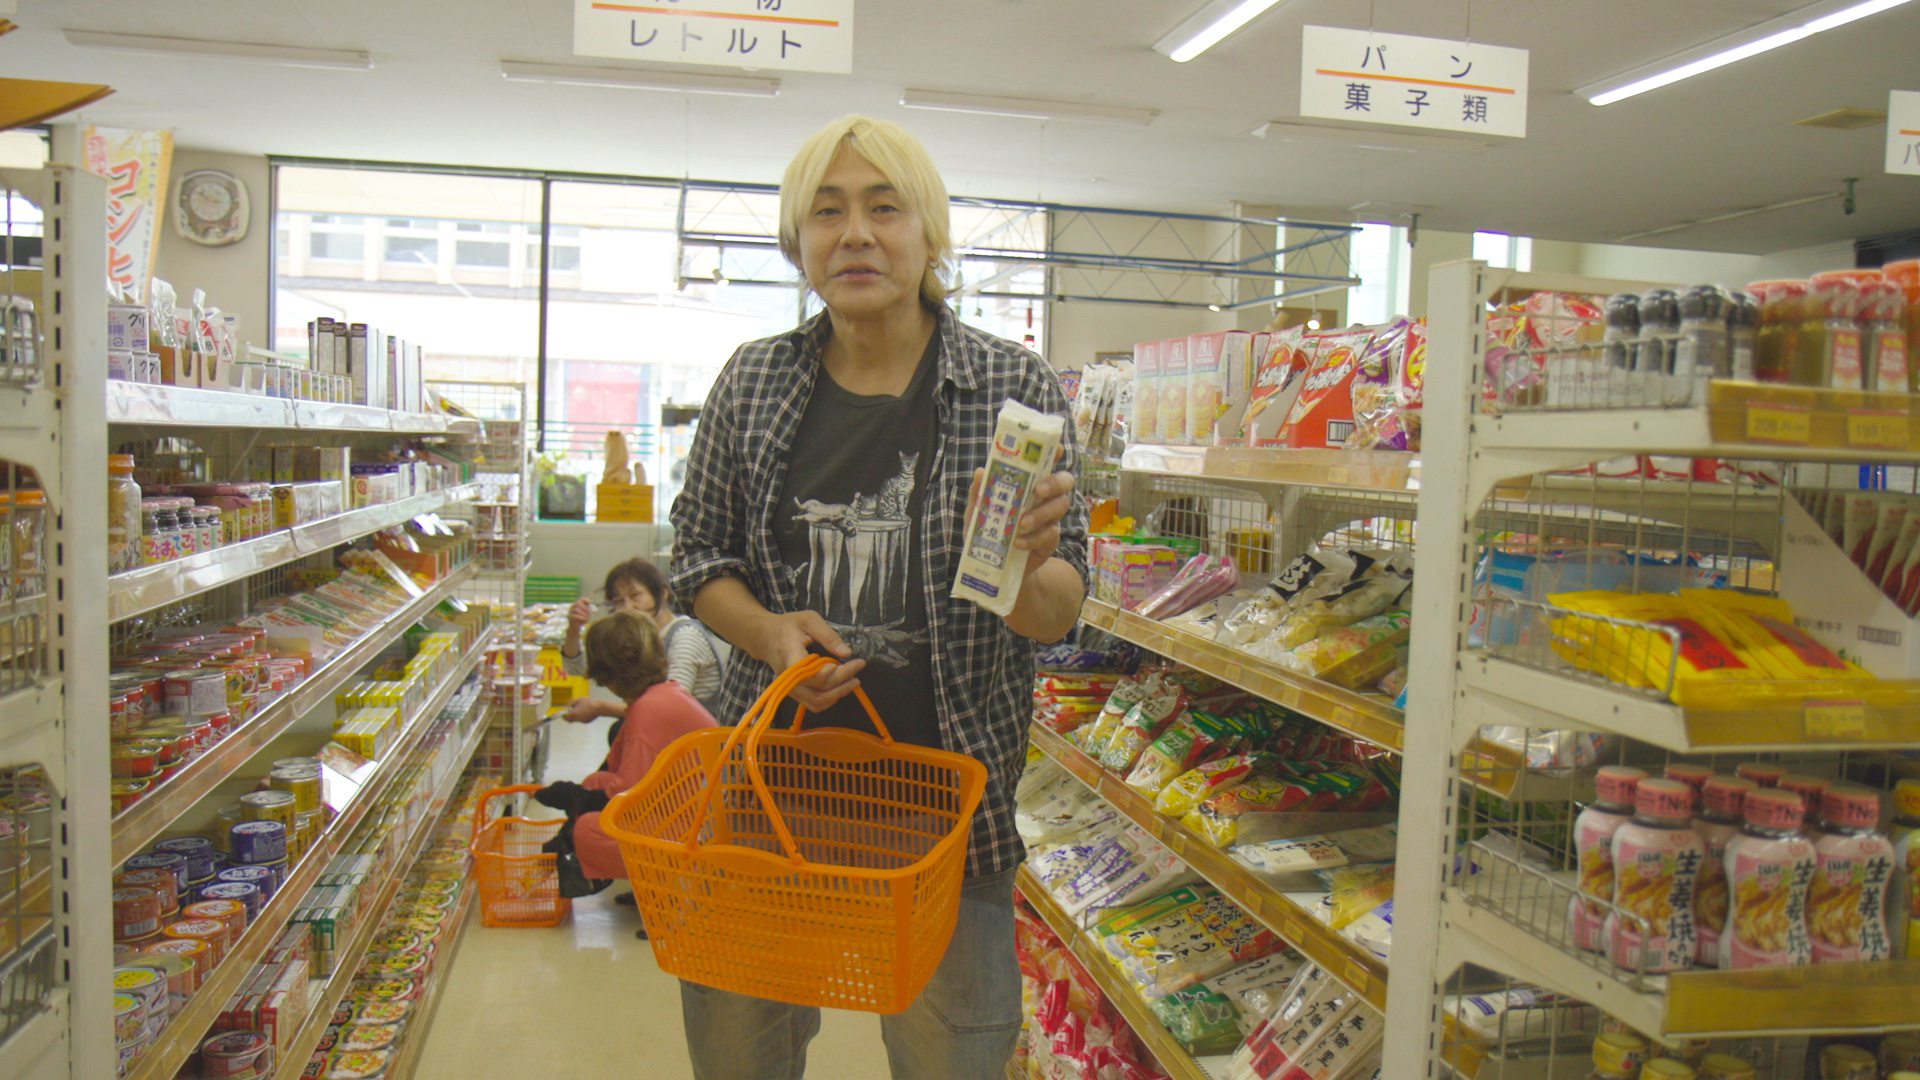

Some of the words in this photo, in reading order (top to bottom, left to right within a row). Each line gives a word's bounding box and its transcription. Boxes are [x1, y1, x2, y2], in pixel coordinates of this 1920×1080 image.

[631, 19, 802, 59] レトルト
[1361, 45, 1472, 78] パン
[1344, 83, 1488, 123] 菓子類
